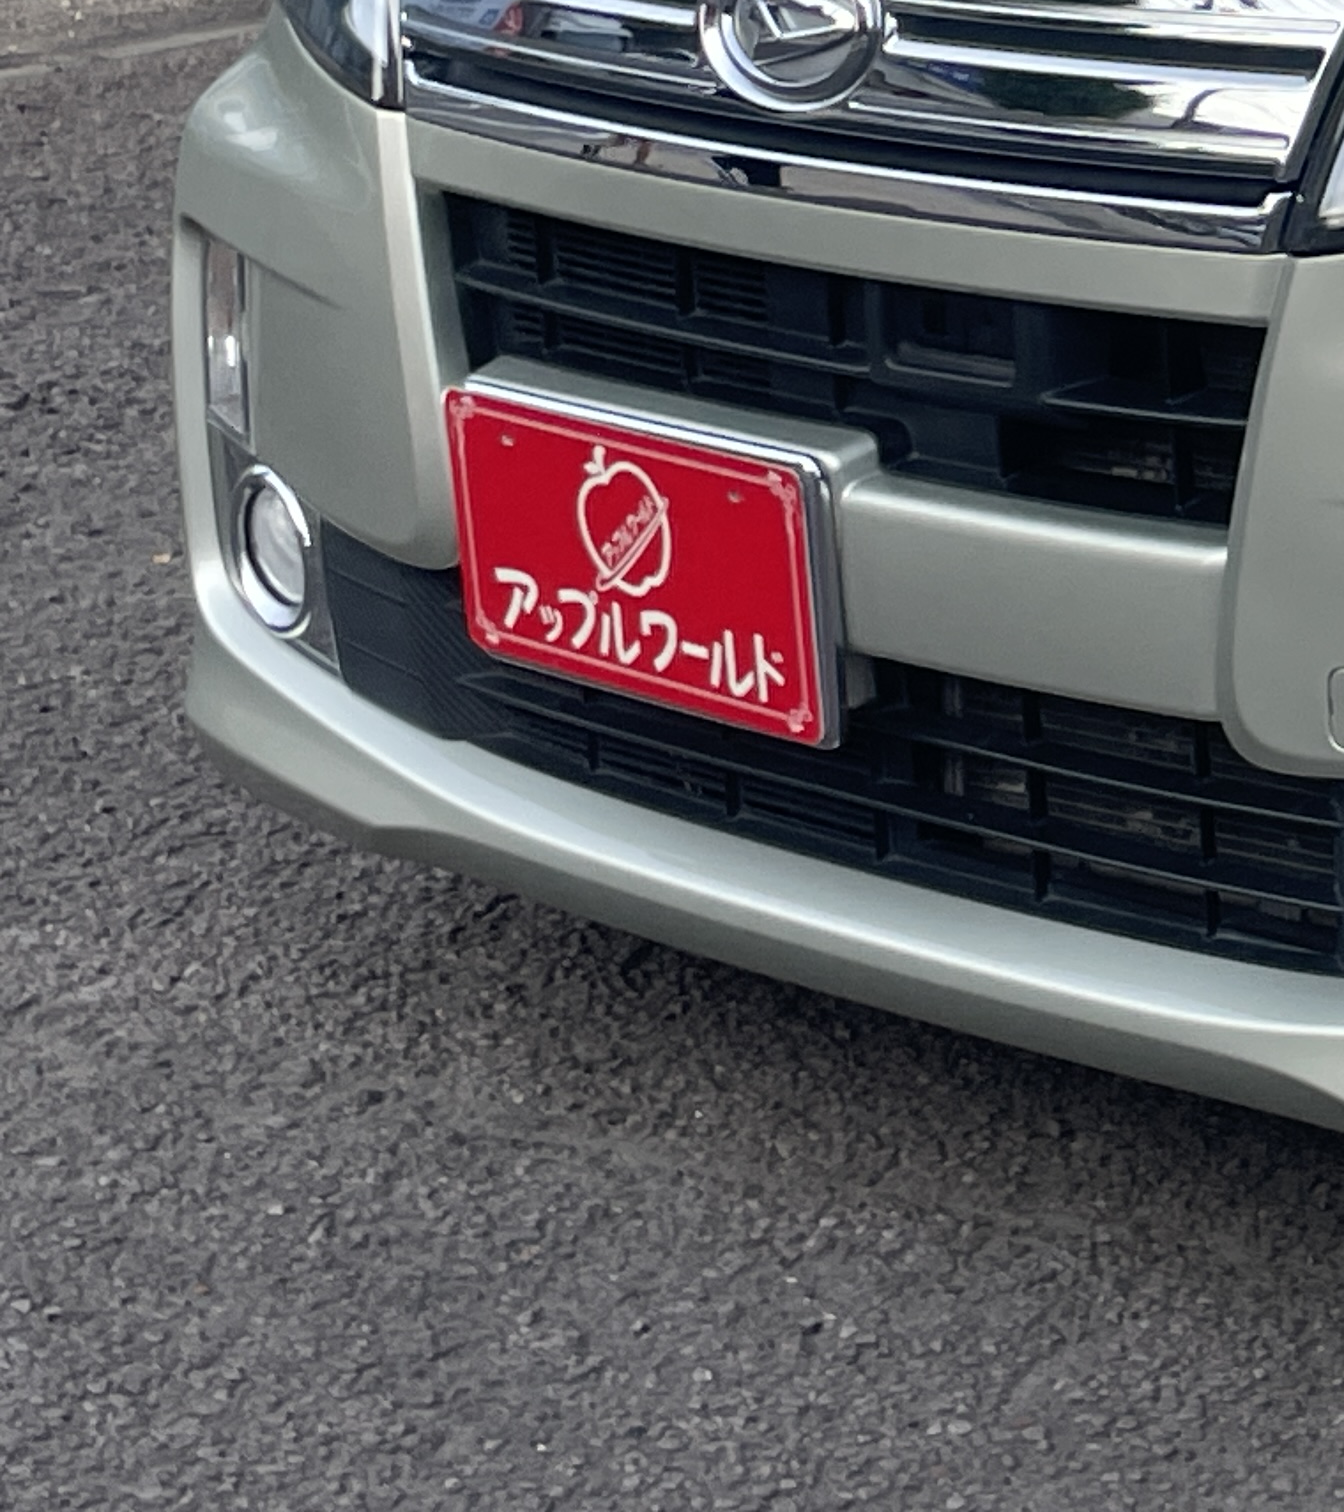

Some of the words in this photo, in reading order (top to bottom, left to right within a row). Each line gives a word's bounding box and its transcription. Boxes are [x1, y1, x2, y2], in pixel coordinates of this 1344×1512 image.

[494, 567, 785, 703] アップルワールド
